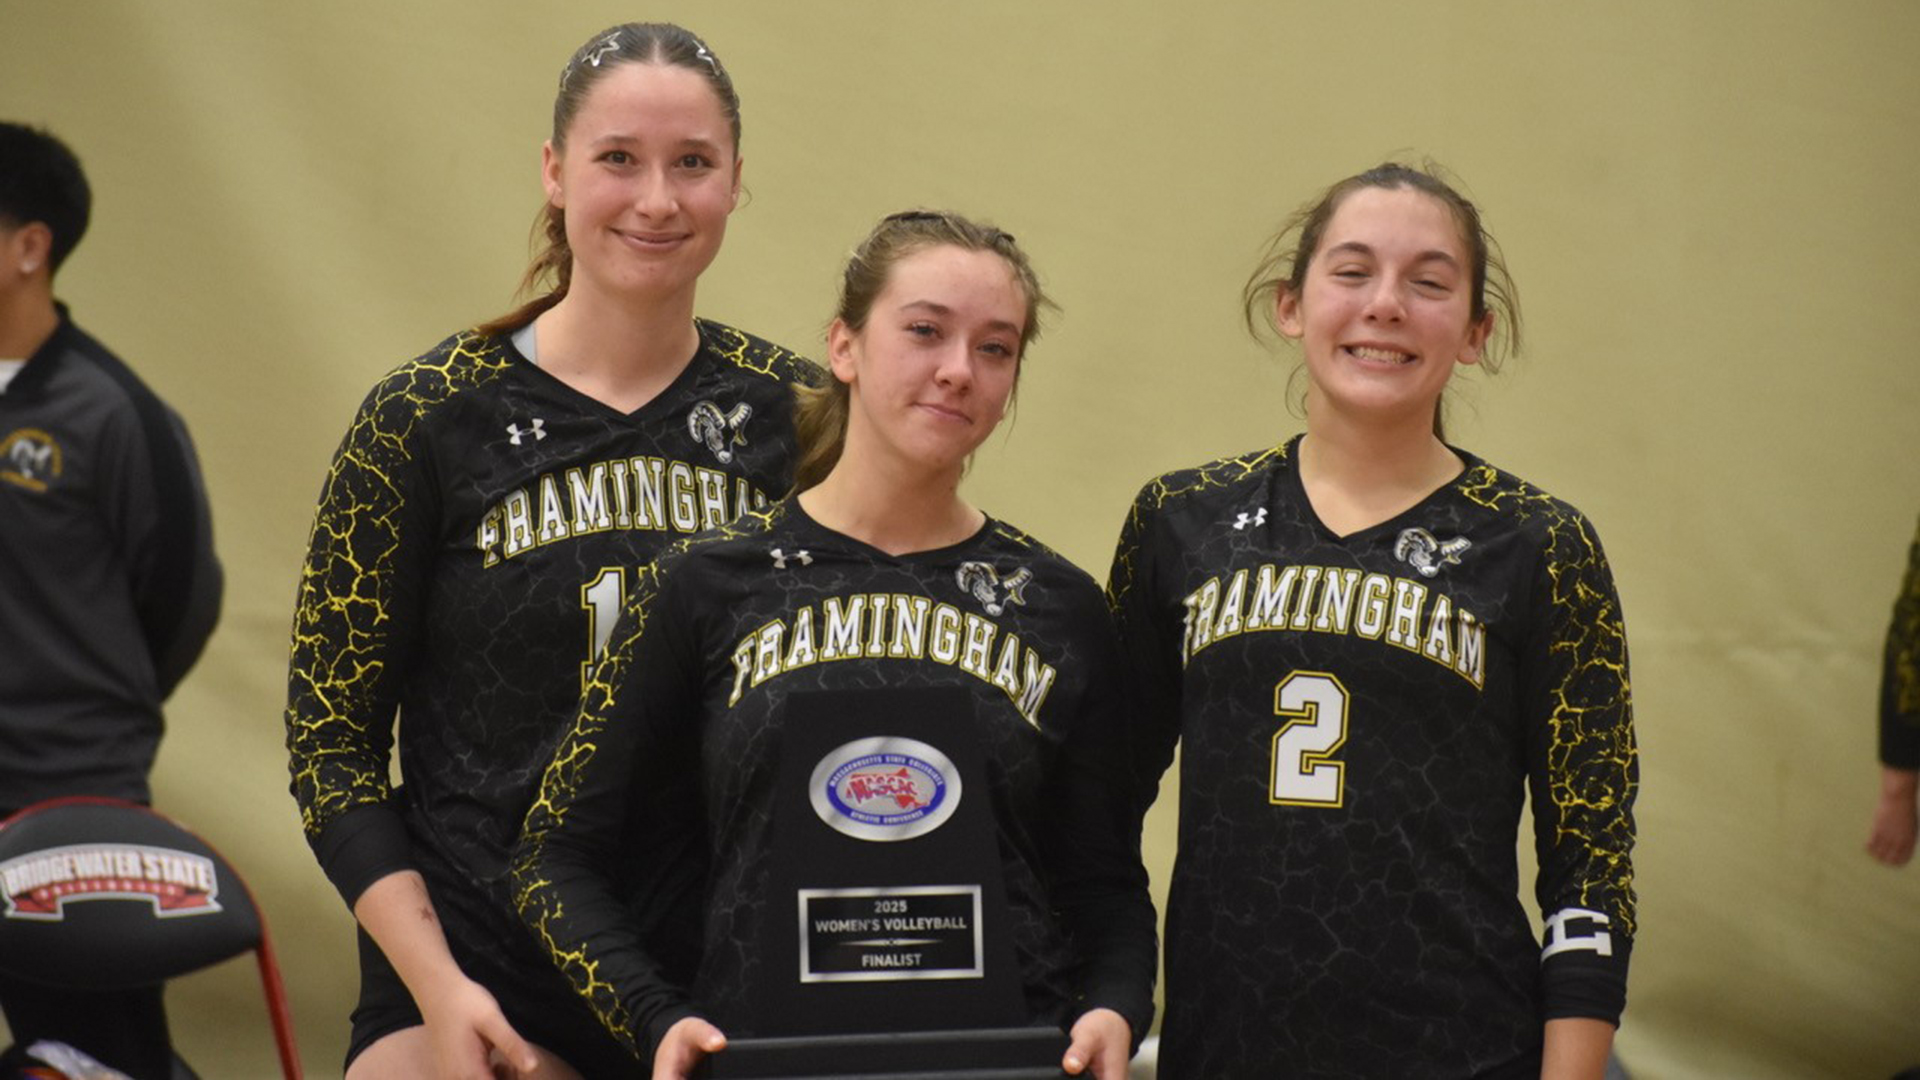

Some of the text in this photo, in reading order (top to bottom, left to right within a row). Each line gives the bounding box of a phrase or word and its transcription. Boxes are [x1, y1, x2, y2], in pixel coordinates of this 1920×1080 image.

[477, 456, 766, 569] FRAMINGHA
[581, 566, 648, 696] 1
[728, 593, 1057, 732] FRAMINGHAM
[1269, 669, 1350, 808] 2
[2, 851, 212, 897] BRIDGEWATER STATE
[874, 900, 908, 914] 2025
[815, 917, 967, 933] WOMEN'S VOLLEYBALL
[861, 953, 922, 967] FINALIST
